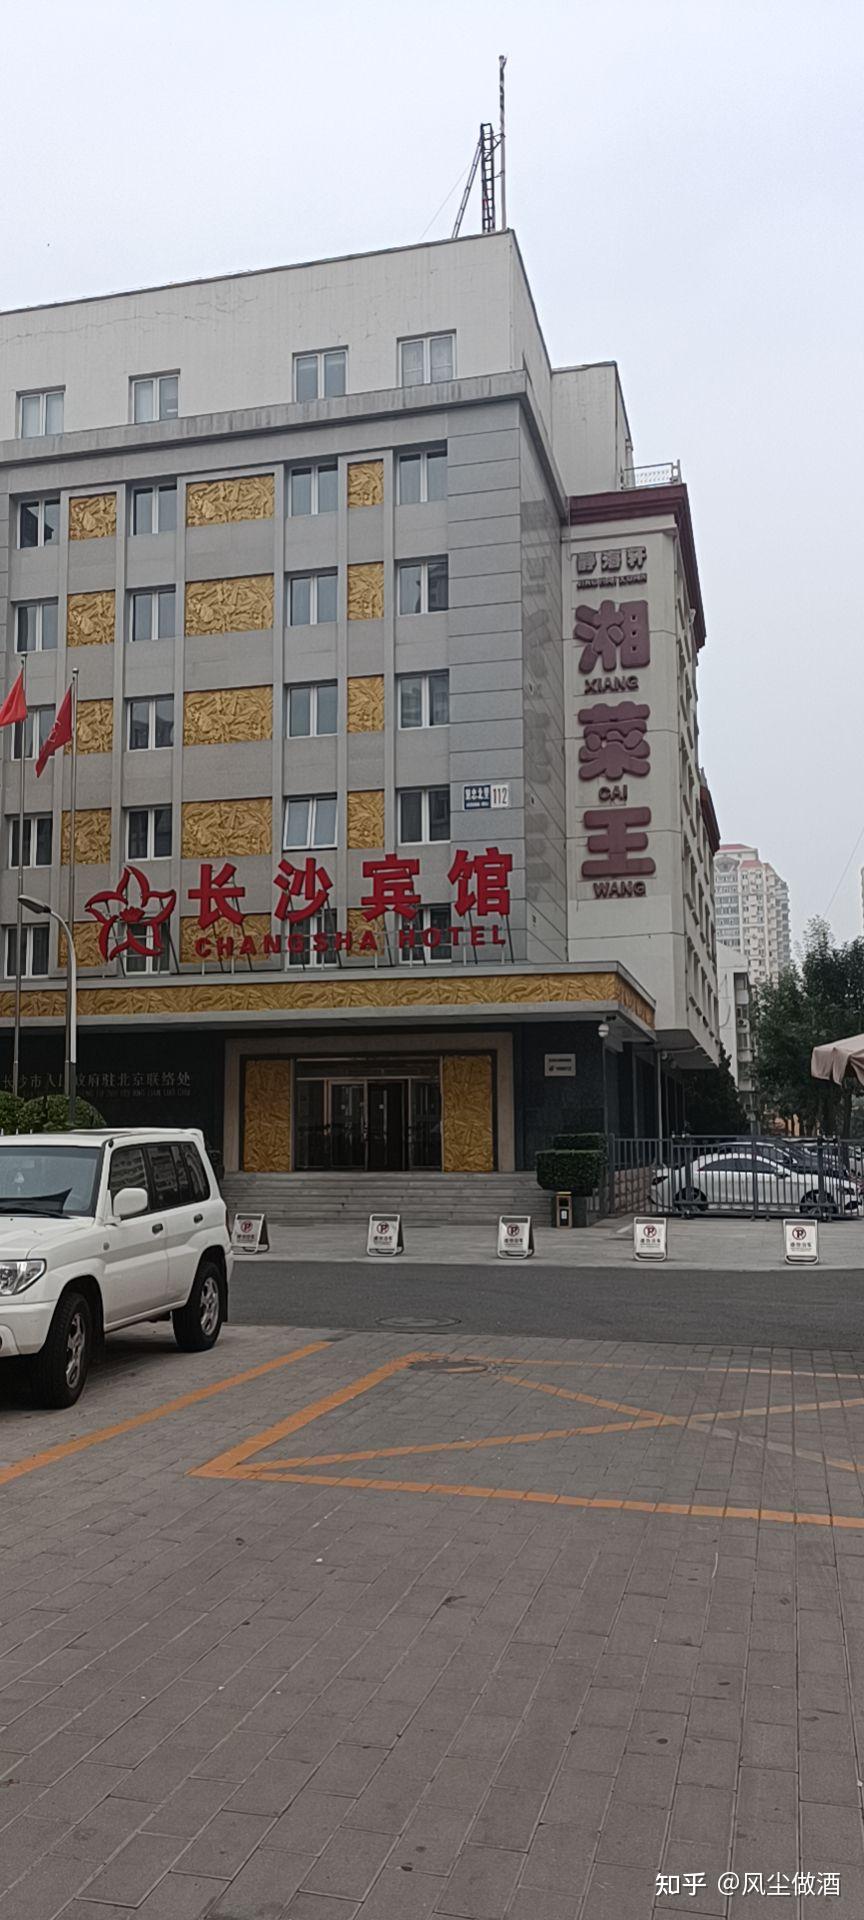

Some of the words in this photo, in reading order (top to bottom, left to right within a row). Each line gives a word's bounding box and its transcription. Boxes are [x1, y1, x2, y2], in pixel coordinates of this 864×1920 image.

[584, 675, 639, 695] XIANG
[493, 787, 508, 804] 112
[598, 785, 628, 802] CAI
[188, 847, 512, 930] 长沙宾馆
[593, 881, 646, 899] WANG
[194, 929, 379, 958] CHANGSHA
[399, 924, 507, 949] HOTEL
